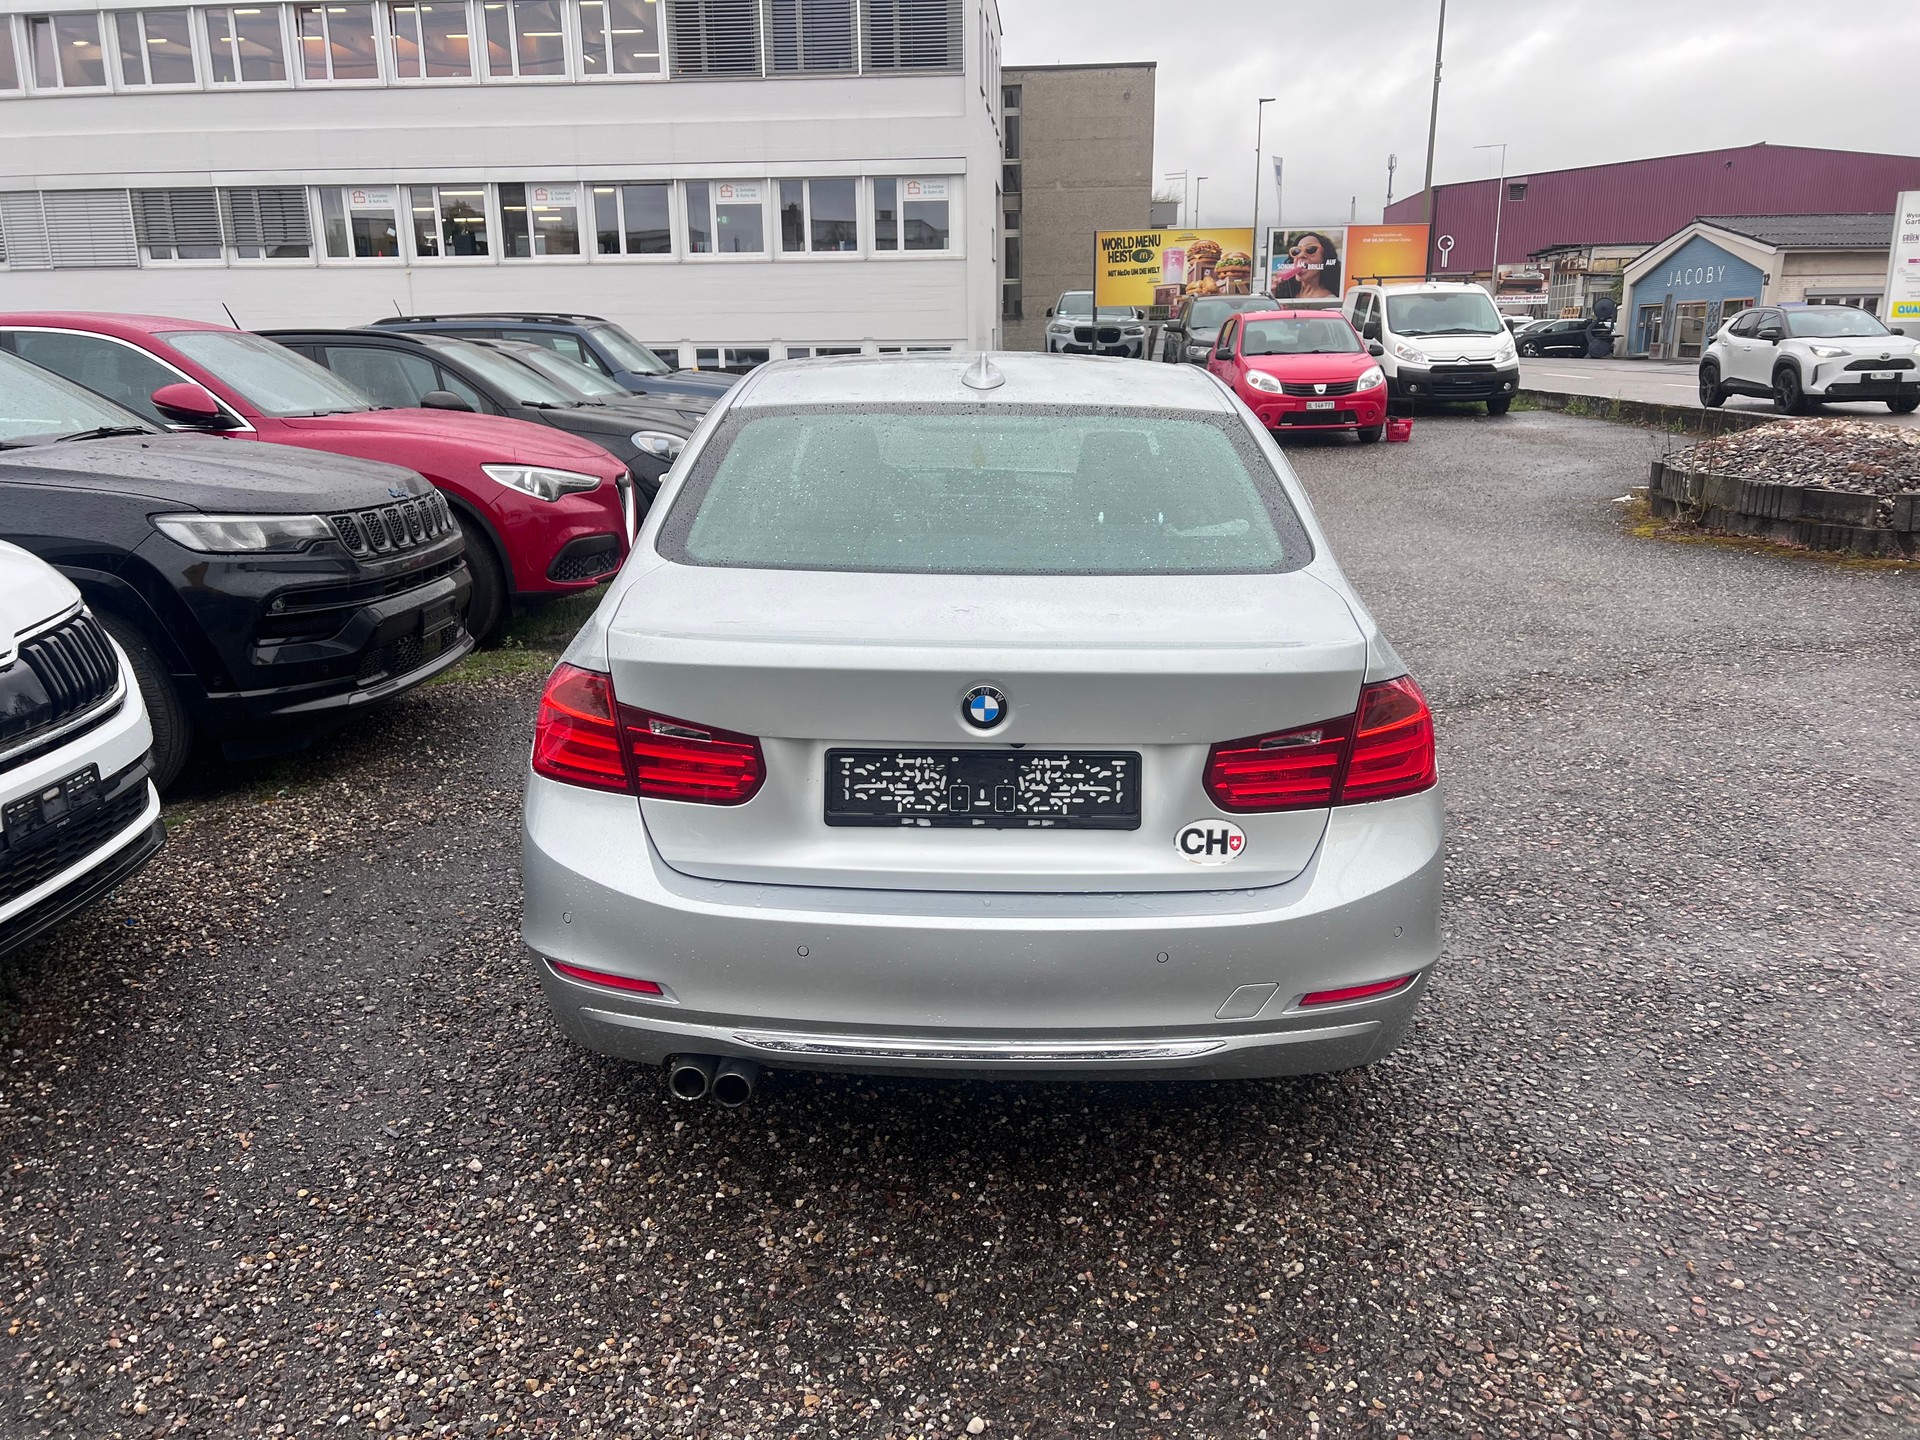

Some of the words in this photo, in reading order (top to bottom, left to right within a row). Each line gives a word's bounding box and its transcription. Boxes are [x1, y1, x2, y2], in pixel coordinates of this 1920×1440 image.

[1101, 236, 1135, 251] WORLD
[1135, 233, 1161, 248] MENU
[1108, 249, 1133, 264] HEIST
[1666, 265, 1725, 287] JACOBY
[1763, 273, 1770, 286] 12
[1898, 306, 1920, 314] QUA
[966, 688, 1004, 702] BMW
[1180, 828, 1229, 855] CH
